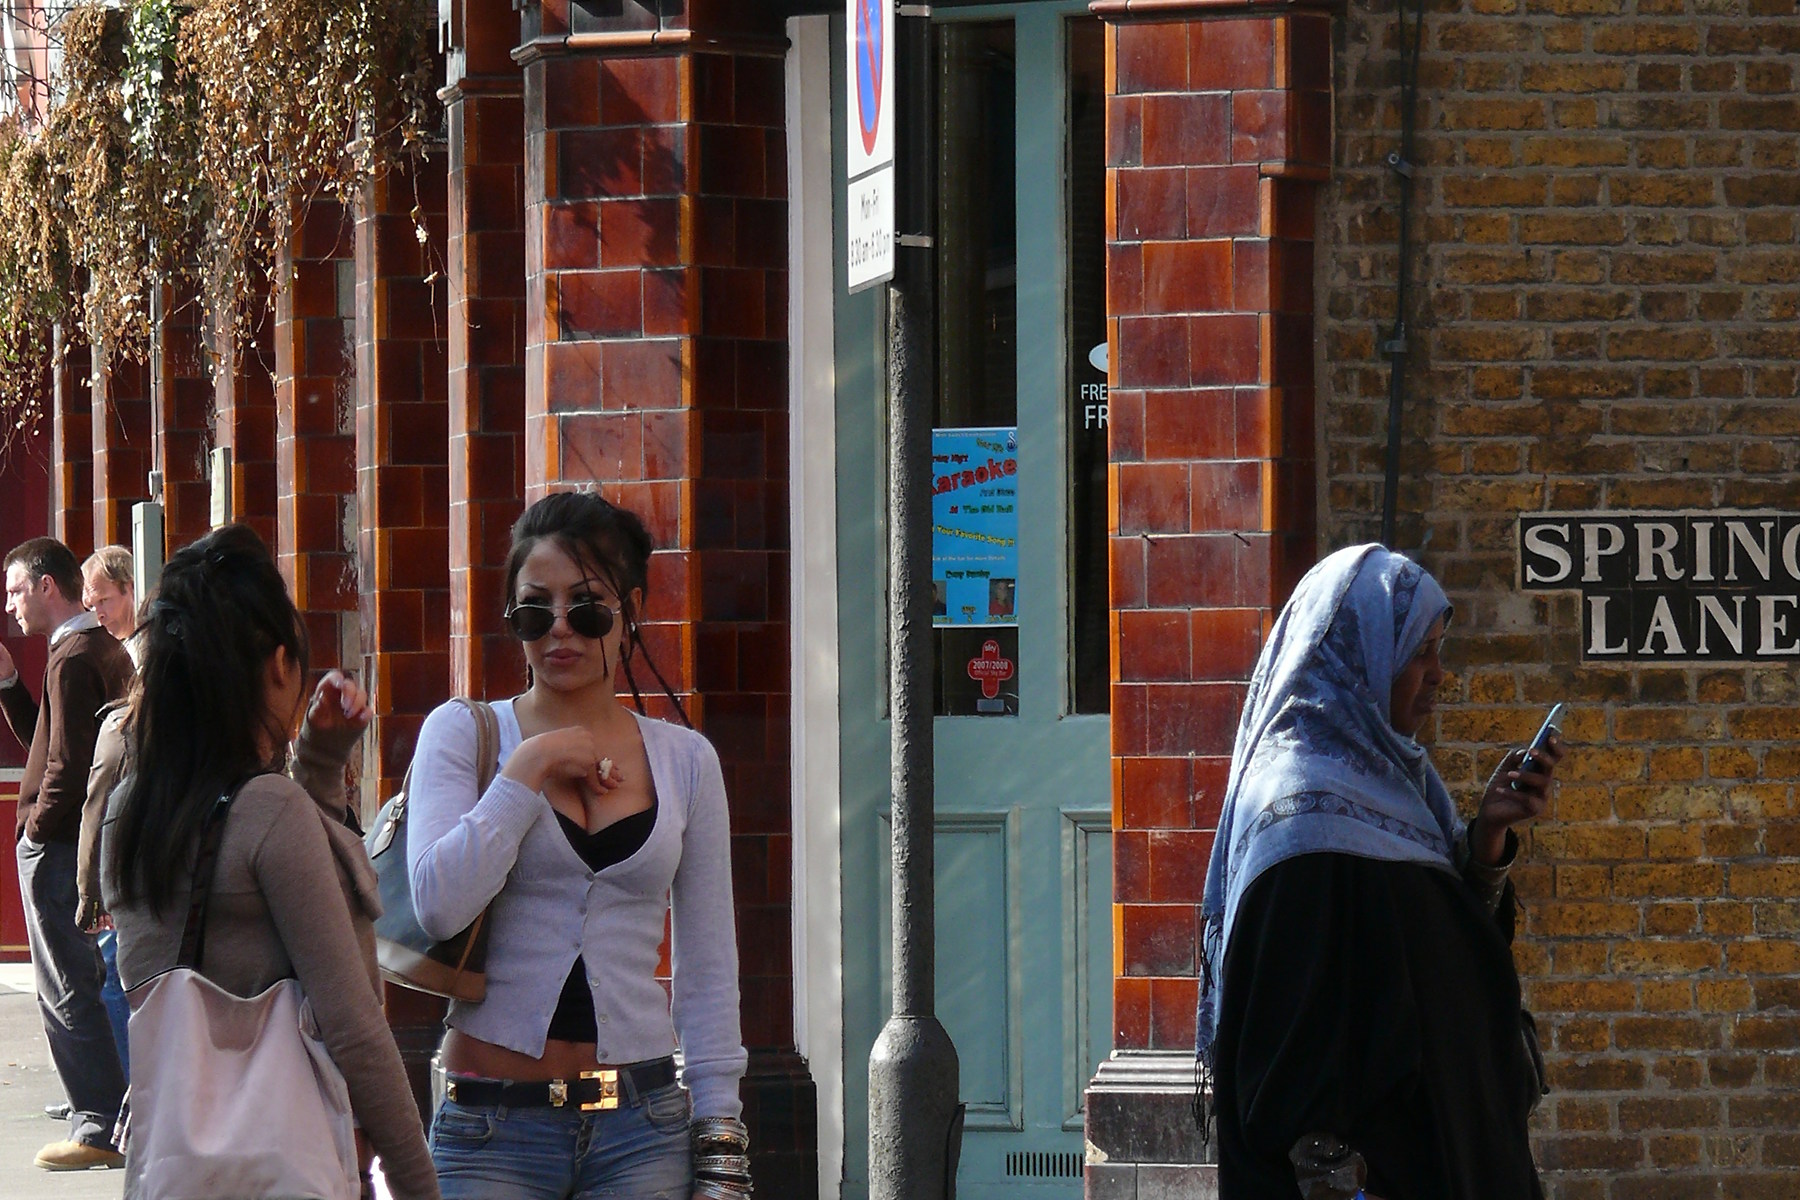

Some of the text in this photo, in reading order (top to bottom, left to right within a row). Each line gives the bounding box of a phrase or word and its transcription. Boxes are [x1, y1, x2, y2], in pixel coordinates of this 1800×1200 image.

[937, 524, 954, 536] Your
[955, 527, 986, 543] Favorite
[987, 536, 1006, 548] Song
[1587, 595, 1800, 655] LANE
[973, 660, 1009, 671] 2007/2008
